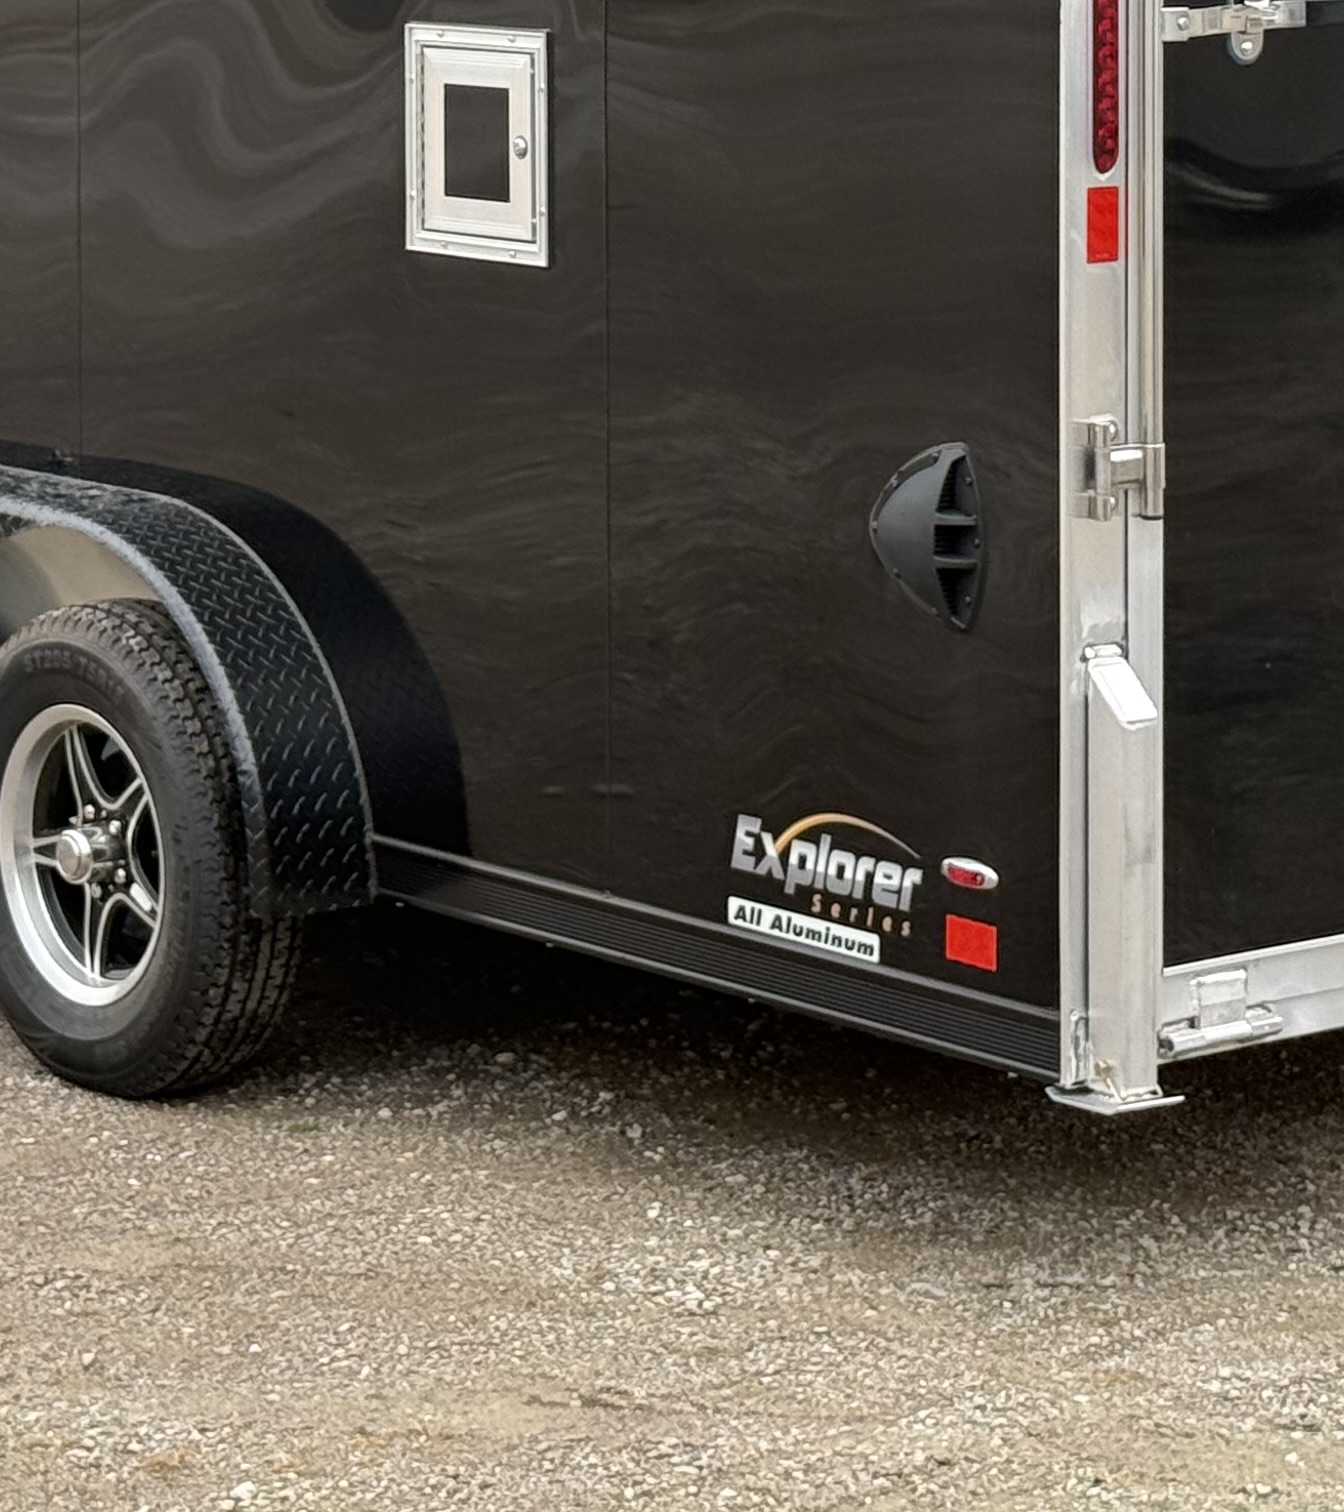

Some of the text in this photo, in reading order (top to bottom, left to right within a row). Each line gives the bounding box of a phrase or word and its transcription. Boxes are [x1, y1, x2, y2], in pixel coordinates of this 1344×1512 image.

[730, 813, 924, 912] Explorer
[733, 904, 875, 957] All Aluminum
